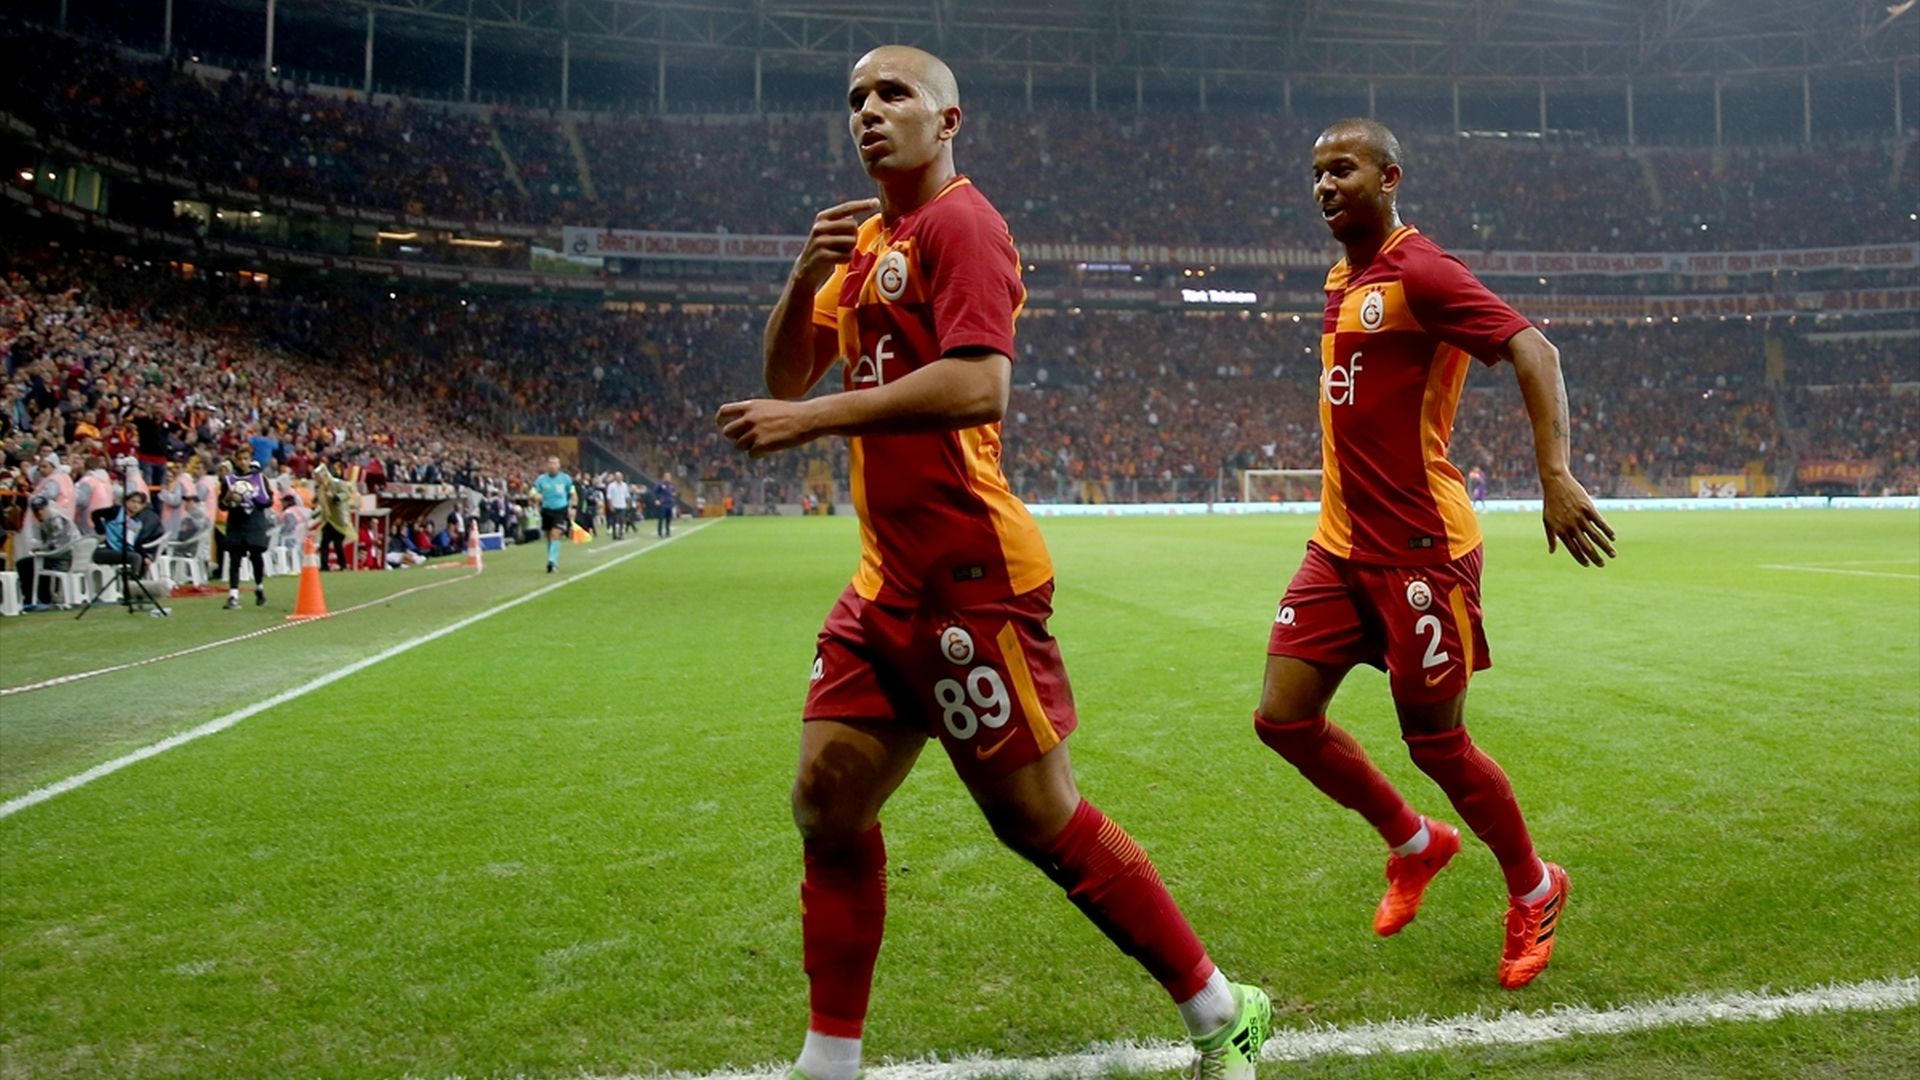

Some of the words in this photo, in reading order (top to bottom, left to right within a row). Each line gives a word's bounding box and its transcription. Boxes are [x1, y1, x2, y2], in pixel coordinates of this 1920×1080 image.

[850, 334, 894, 386] ef
[1415, 614, 1449, 669] 2
[934, 665, 1012, 740] 89
